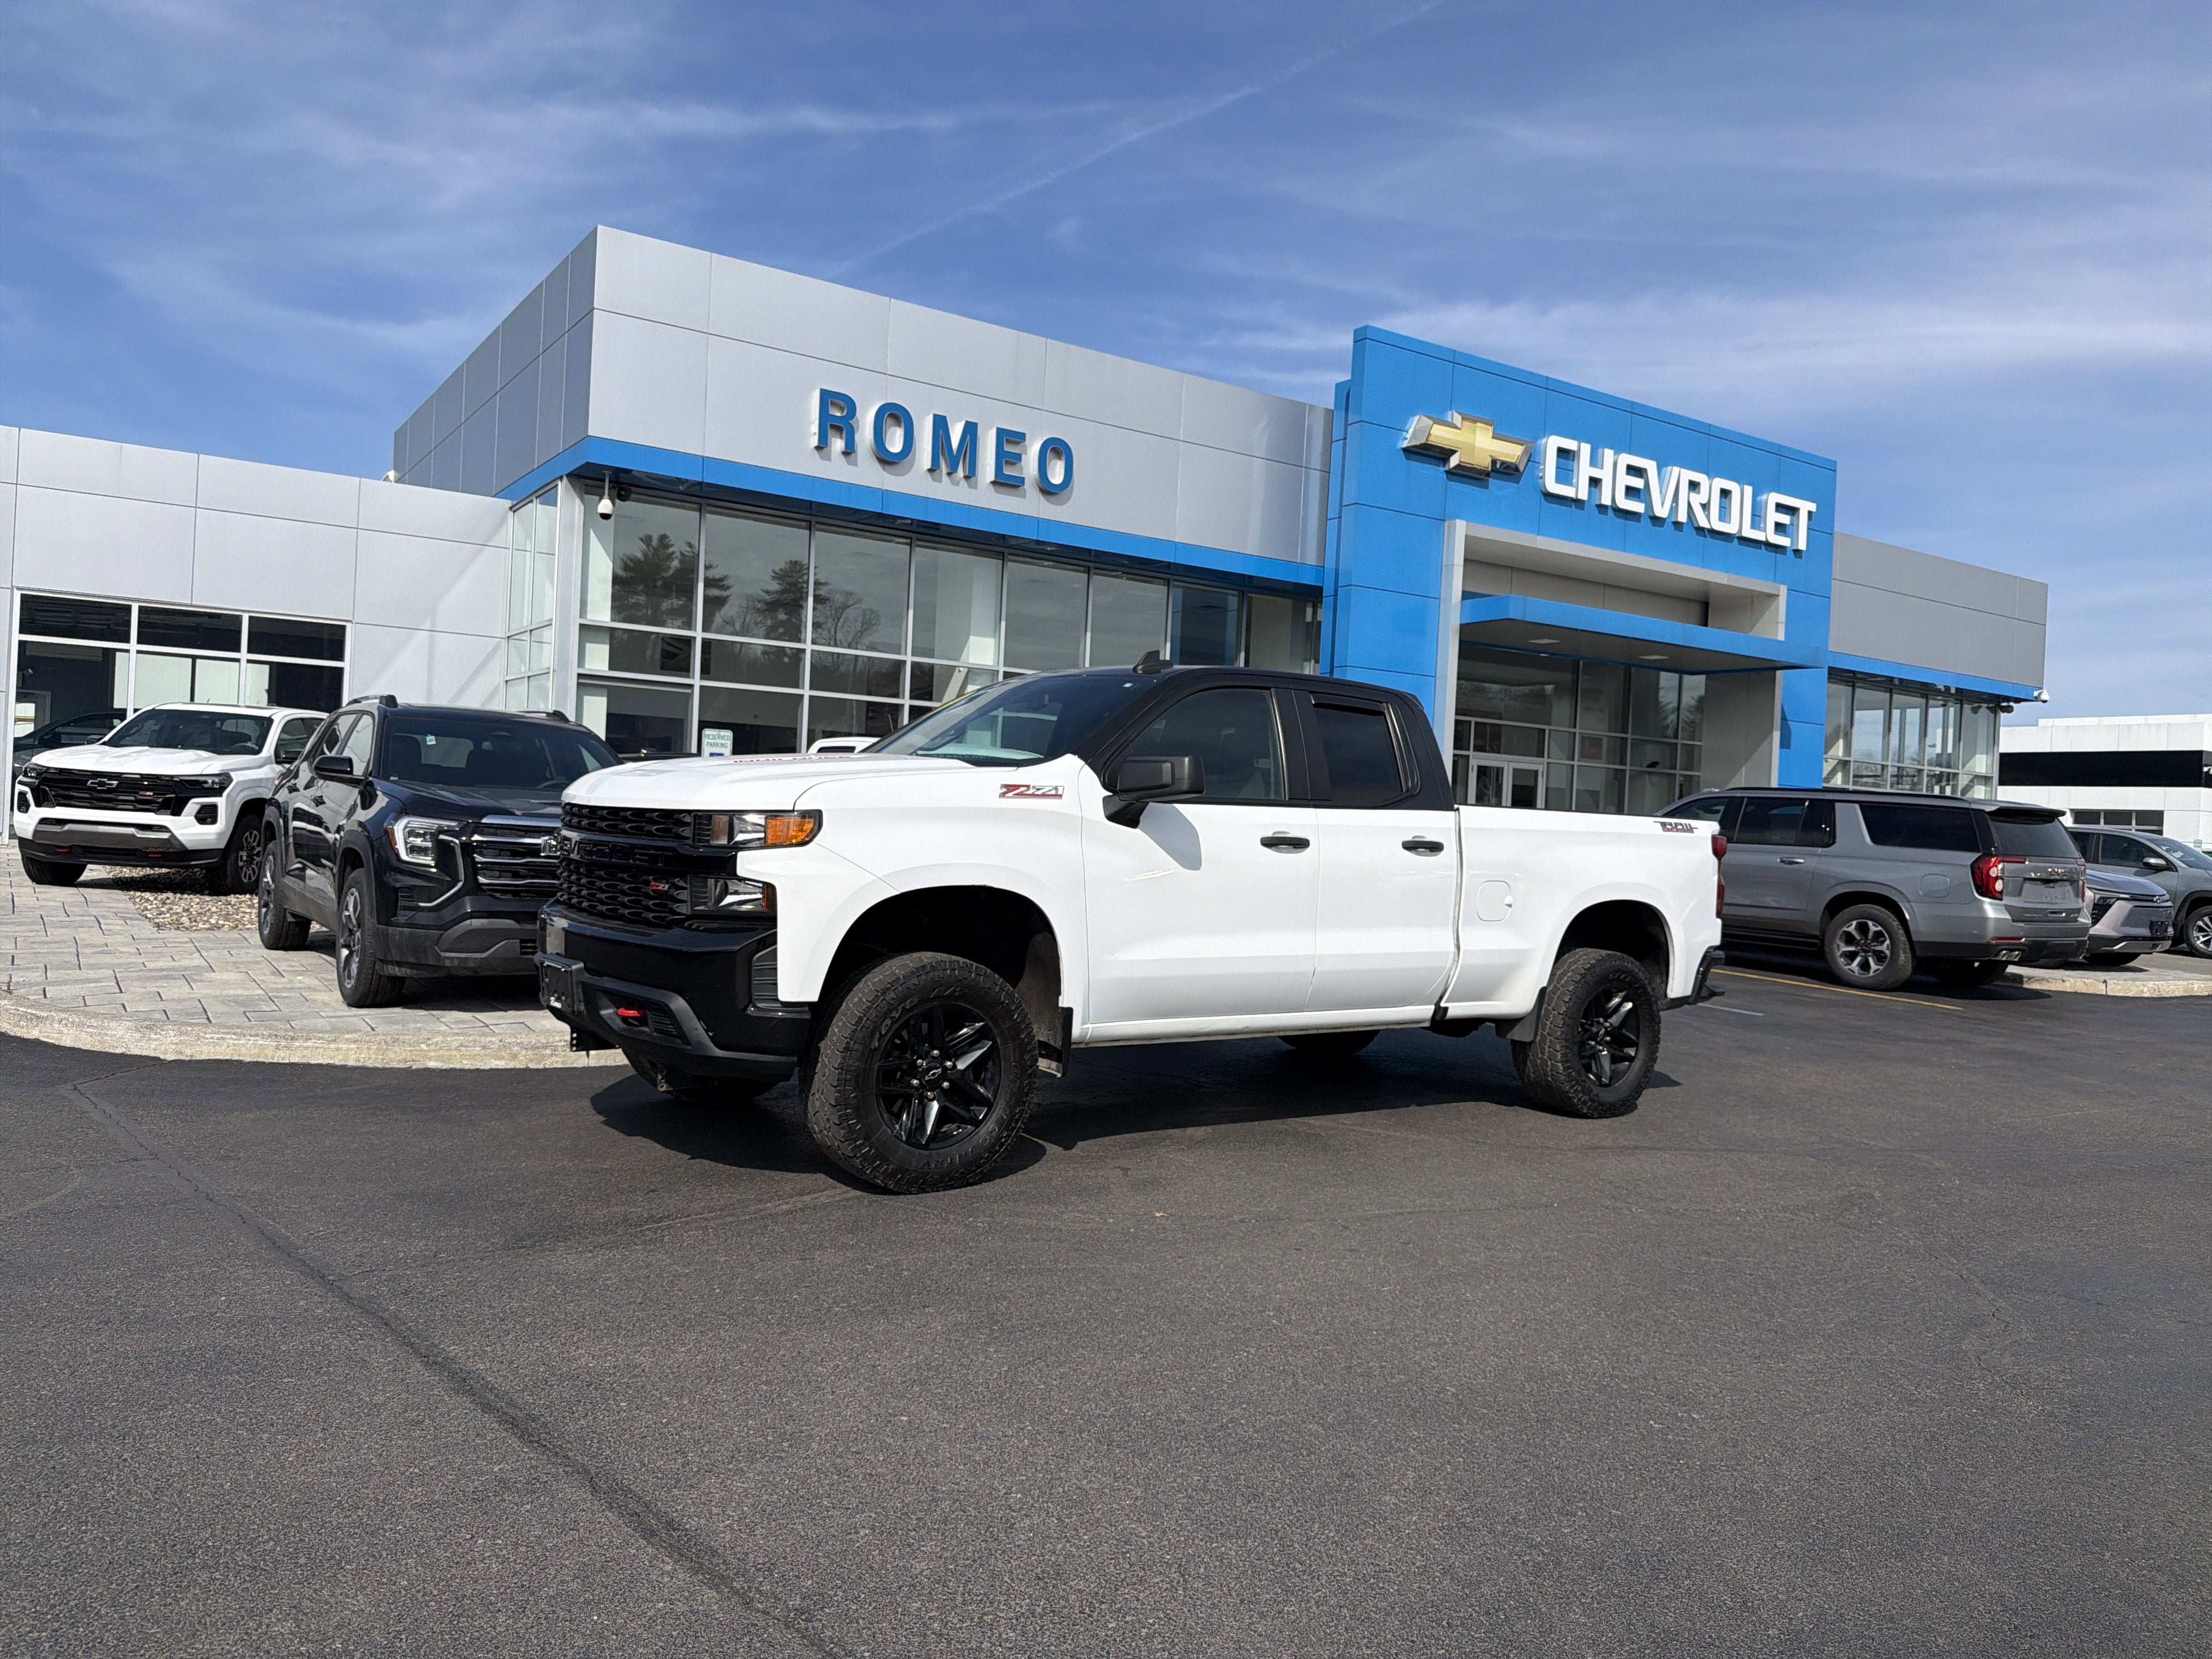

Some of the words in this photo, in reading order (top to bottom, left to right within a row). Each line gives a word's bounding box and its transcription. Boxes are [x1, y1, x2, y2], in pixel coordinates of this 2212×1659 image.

[815, 388, 1074, 494] ROMEO
[1539, 435, 1816, 551] CHEVROLET
[998, 784, 1064, 799] Z71
